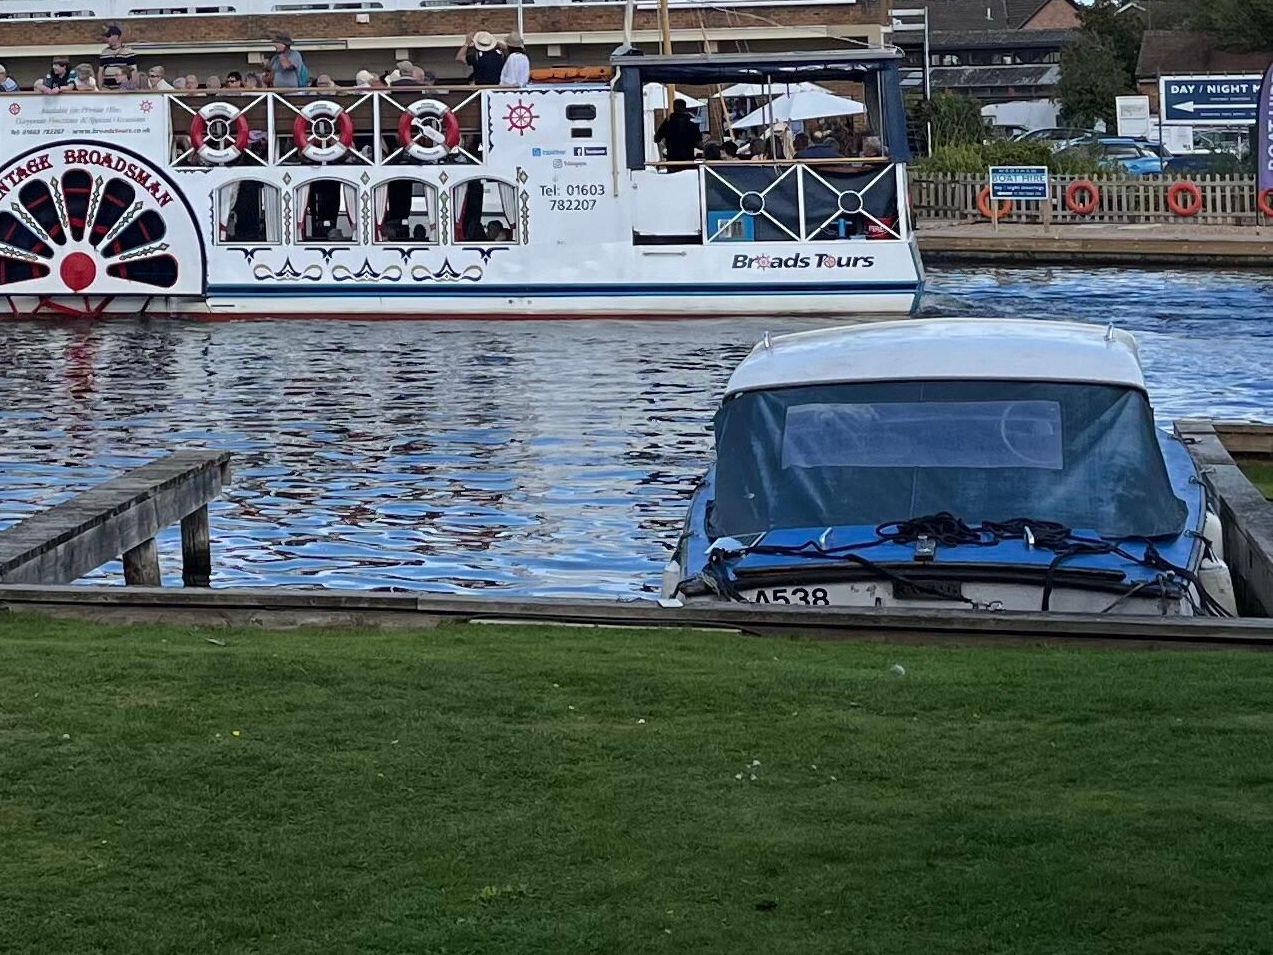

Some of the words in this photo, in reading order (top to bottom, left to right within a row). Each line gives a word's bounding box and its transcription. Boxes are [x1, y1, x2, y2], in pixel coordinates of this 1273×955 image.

[1170, 84, 1195, 94] DAY
[1198, 84, 1204, 94] /
[1207, 84, 1249, 94] NIGHT
[64, 149, 174, 208] BROADSMAN
[992, 175, 1019, 183] BOAT
[1022, 175, 1046, 183] HIRE
[539, 184, 561, 197] Tel:
[566, 184, 605, 196] 01603
[549, 199, 597, 211] 782207
